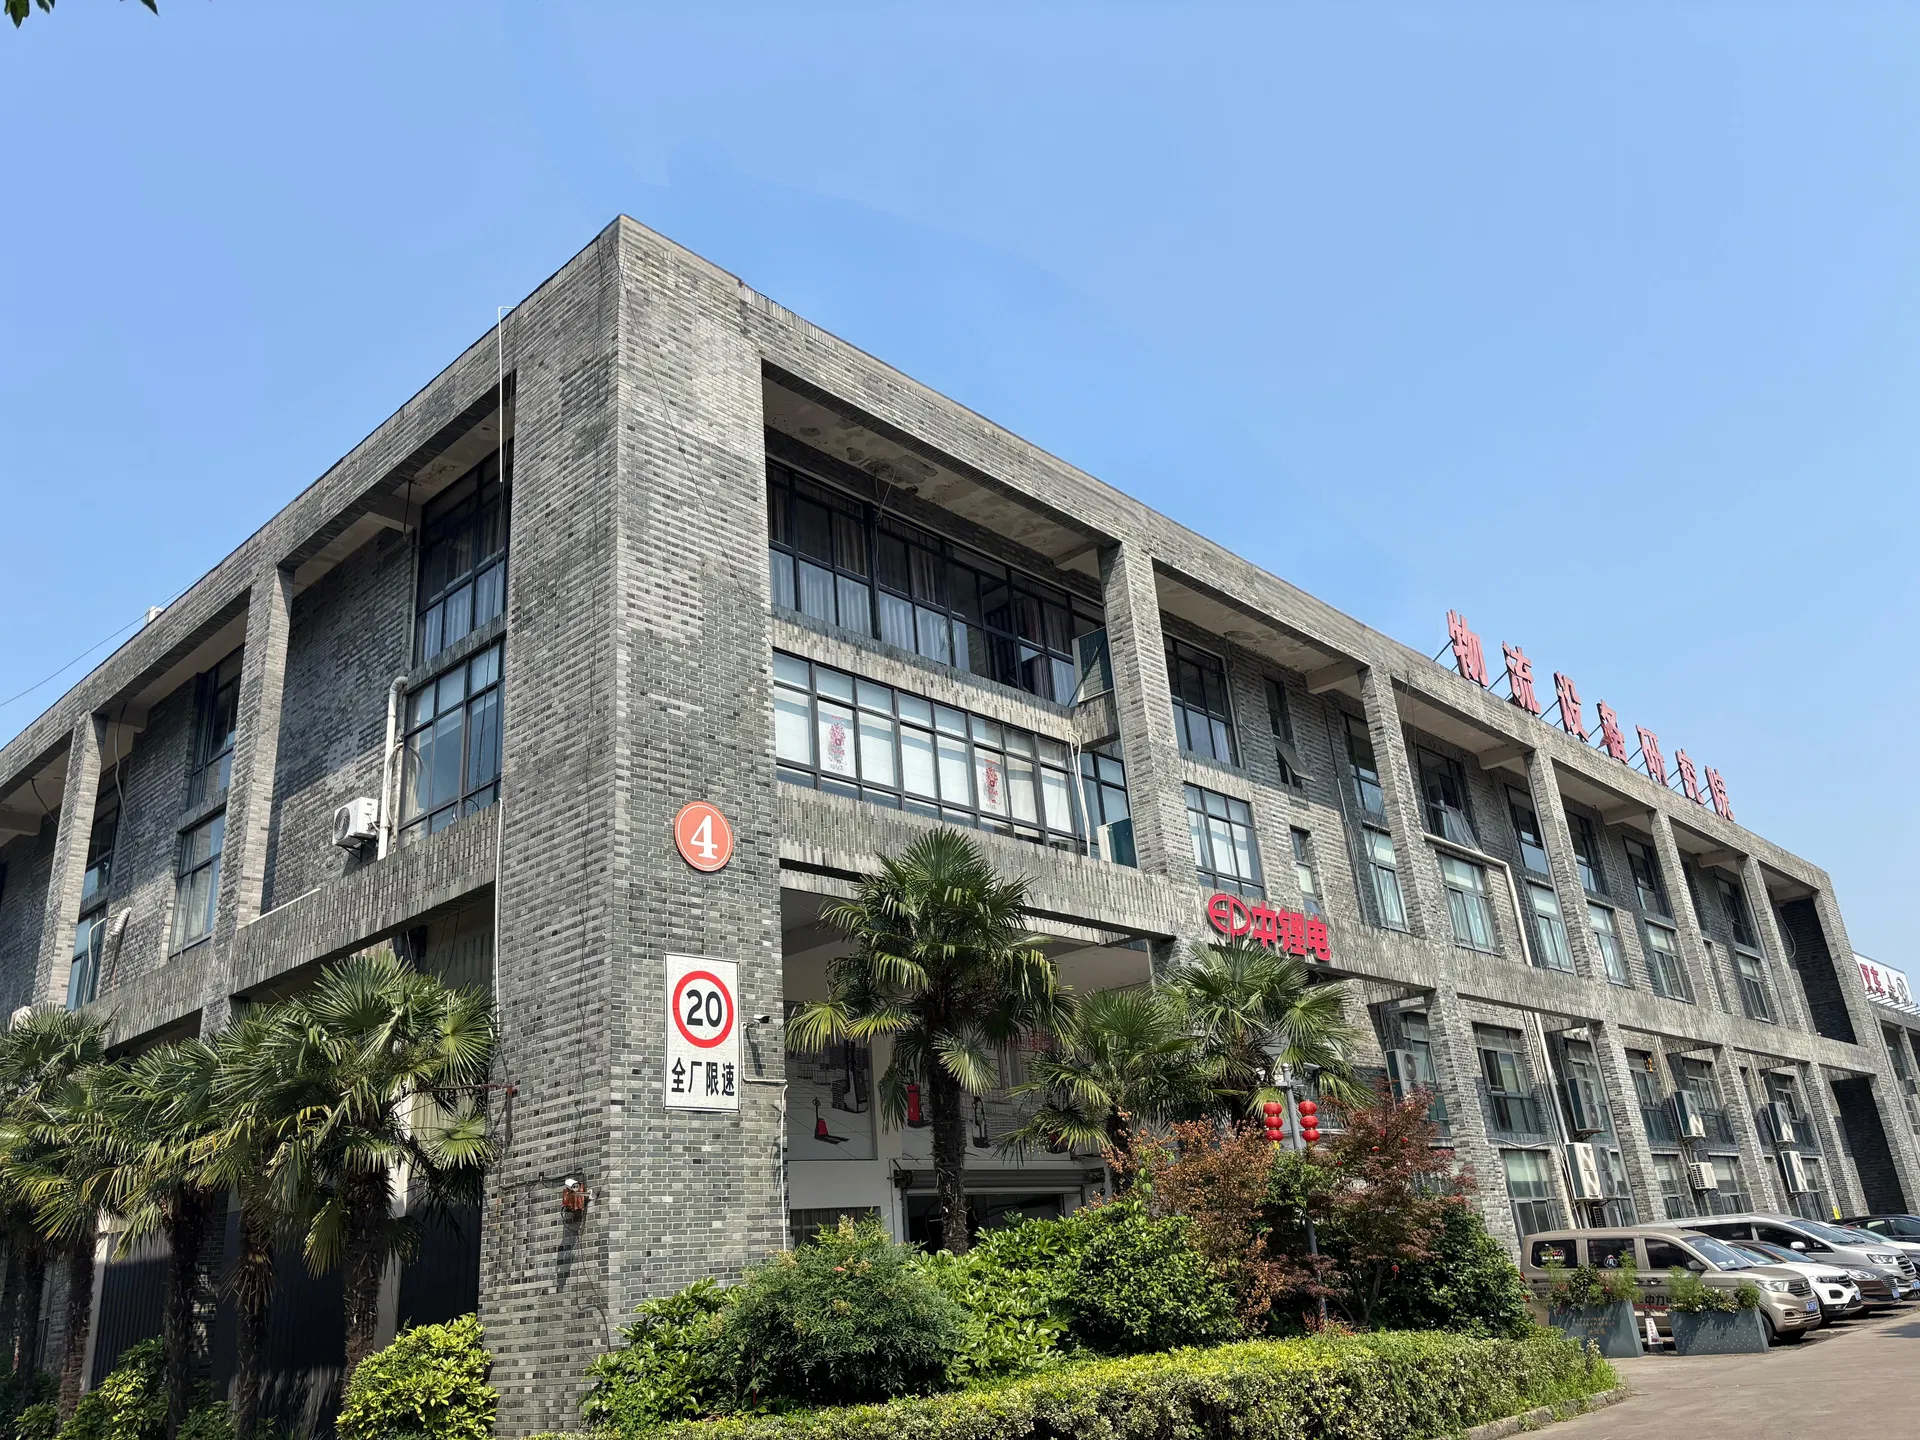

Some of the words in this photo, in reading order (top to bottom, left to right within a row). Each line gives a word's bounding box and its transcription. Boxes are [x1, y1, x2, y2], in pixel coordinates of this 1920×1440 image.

[1446, 608, 1735, 822] 物流设备研究院
[690, 814, 719, 860] 4
[1251, 901, 1331, 961] 中锂电
[685, 988, 723, 1028] 20
[671, 1057, 736, 1097] 全厂限速
